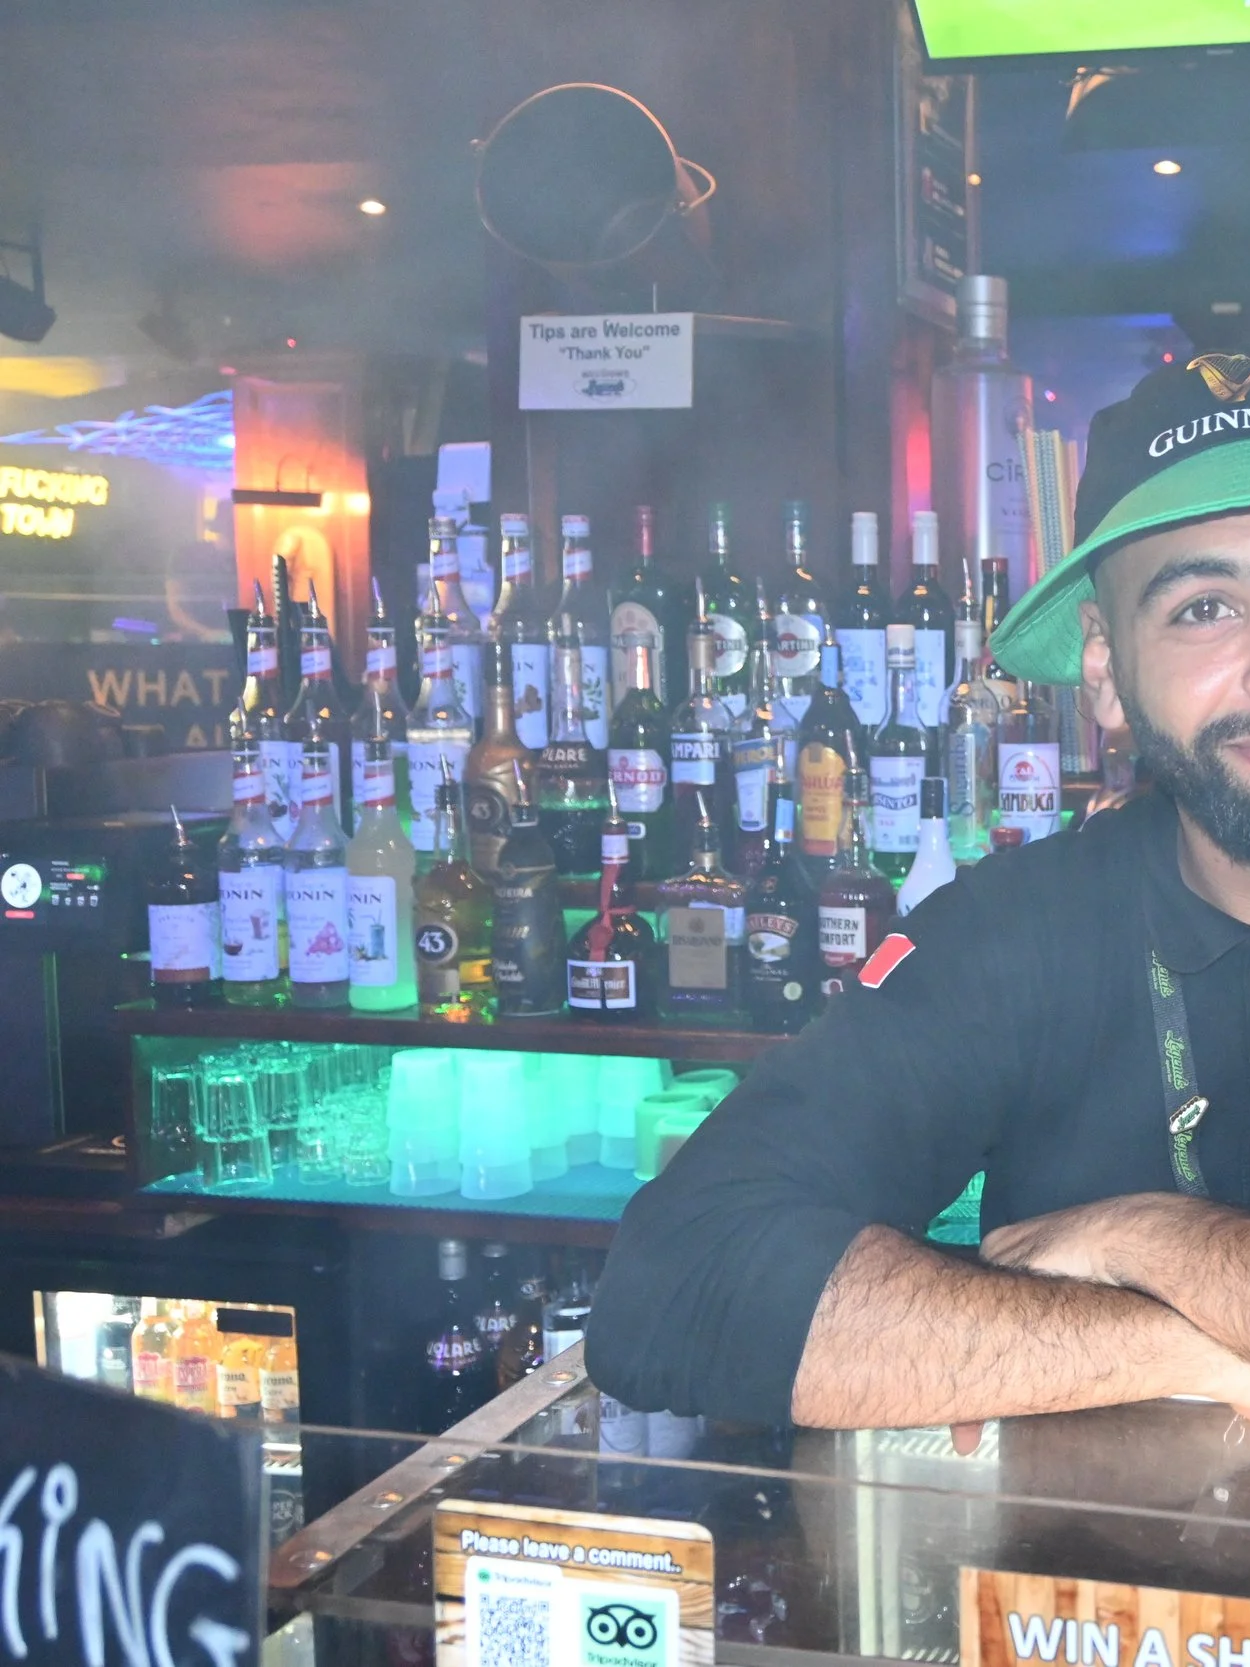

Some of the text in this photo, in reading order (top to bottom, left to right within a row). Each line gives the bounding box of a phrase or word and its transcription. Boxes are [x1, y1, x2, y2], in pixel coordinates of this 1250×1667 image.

[529, 321, 680, 342] Tips are Welcome
[0, 465, 109, 506] FUCKING
[0, 502, 75, 539] TOWN
[87, 669, 229, 707] WHAT
[418, 931, 446, 953] 43
[461, 1529, 520, 1556] Please
[523, 1536, 571, 1562] leave
[573, 1547, 586, 1563] a
[1008, 1611, 1120, 1664] WIN
[1133, 1626, 1171, 1667] A
